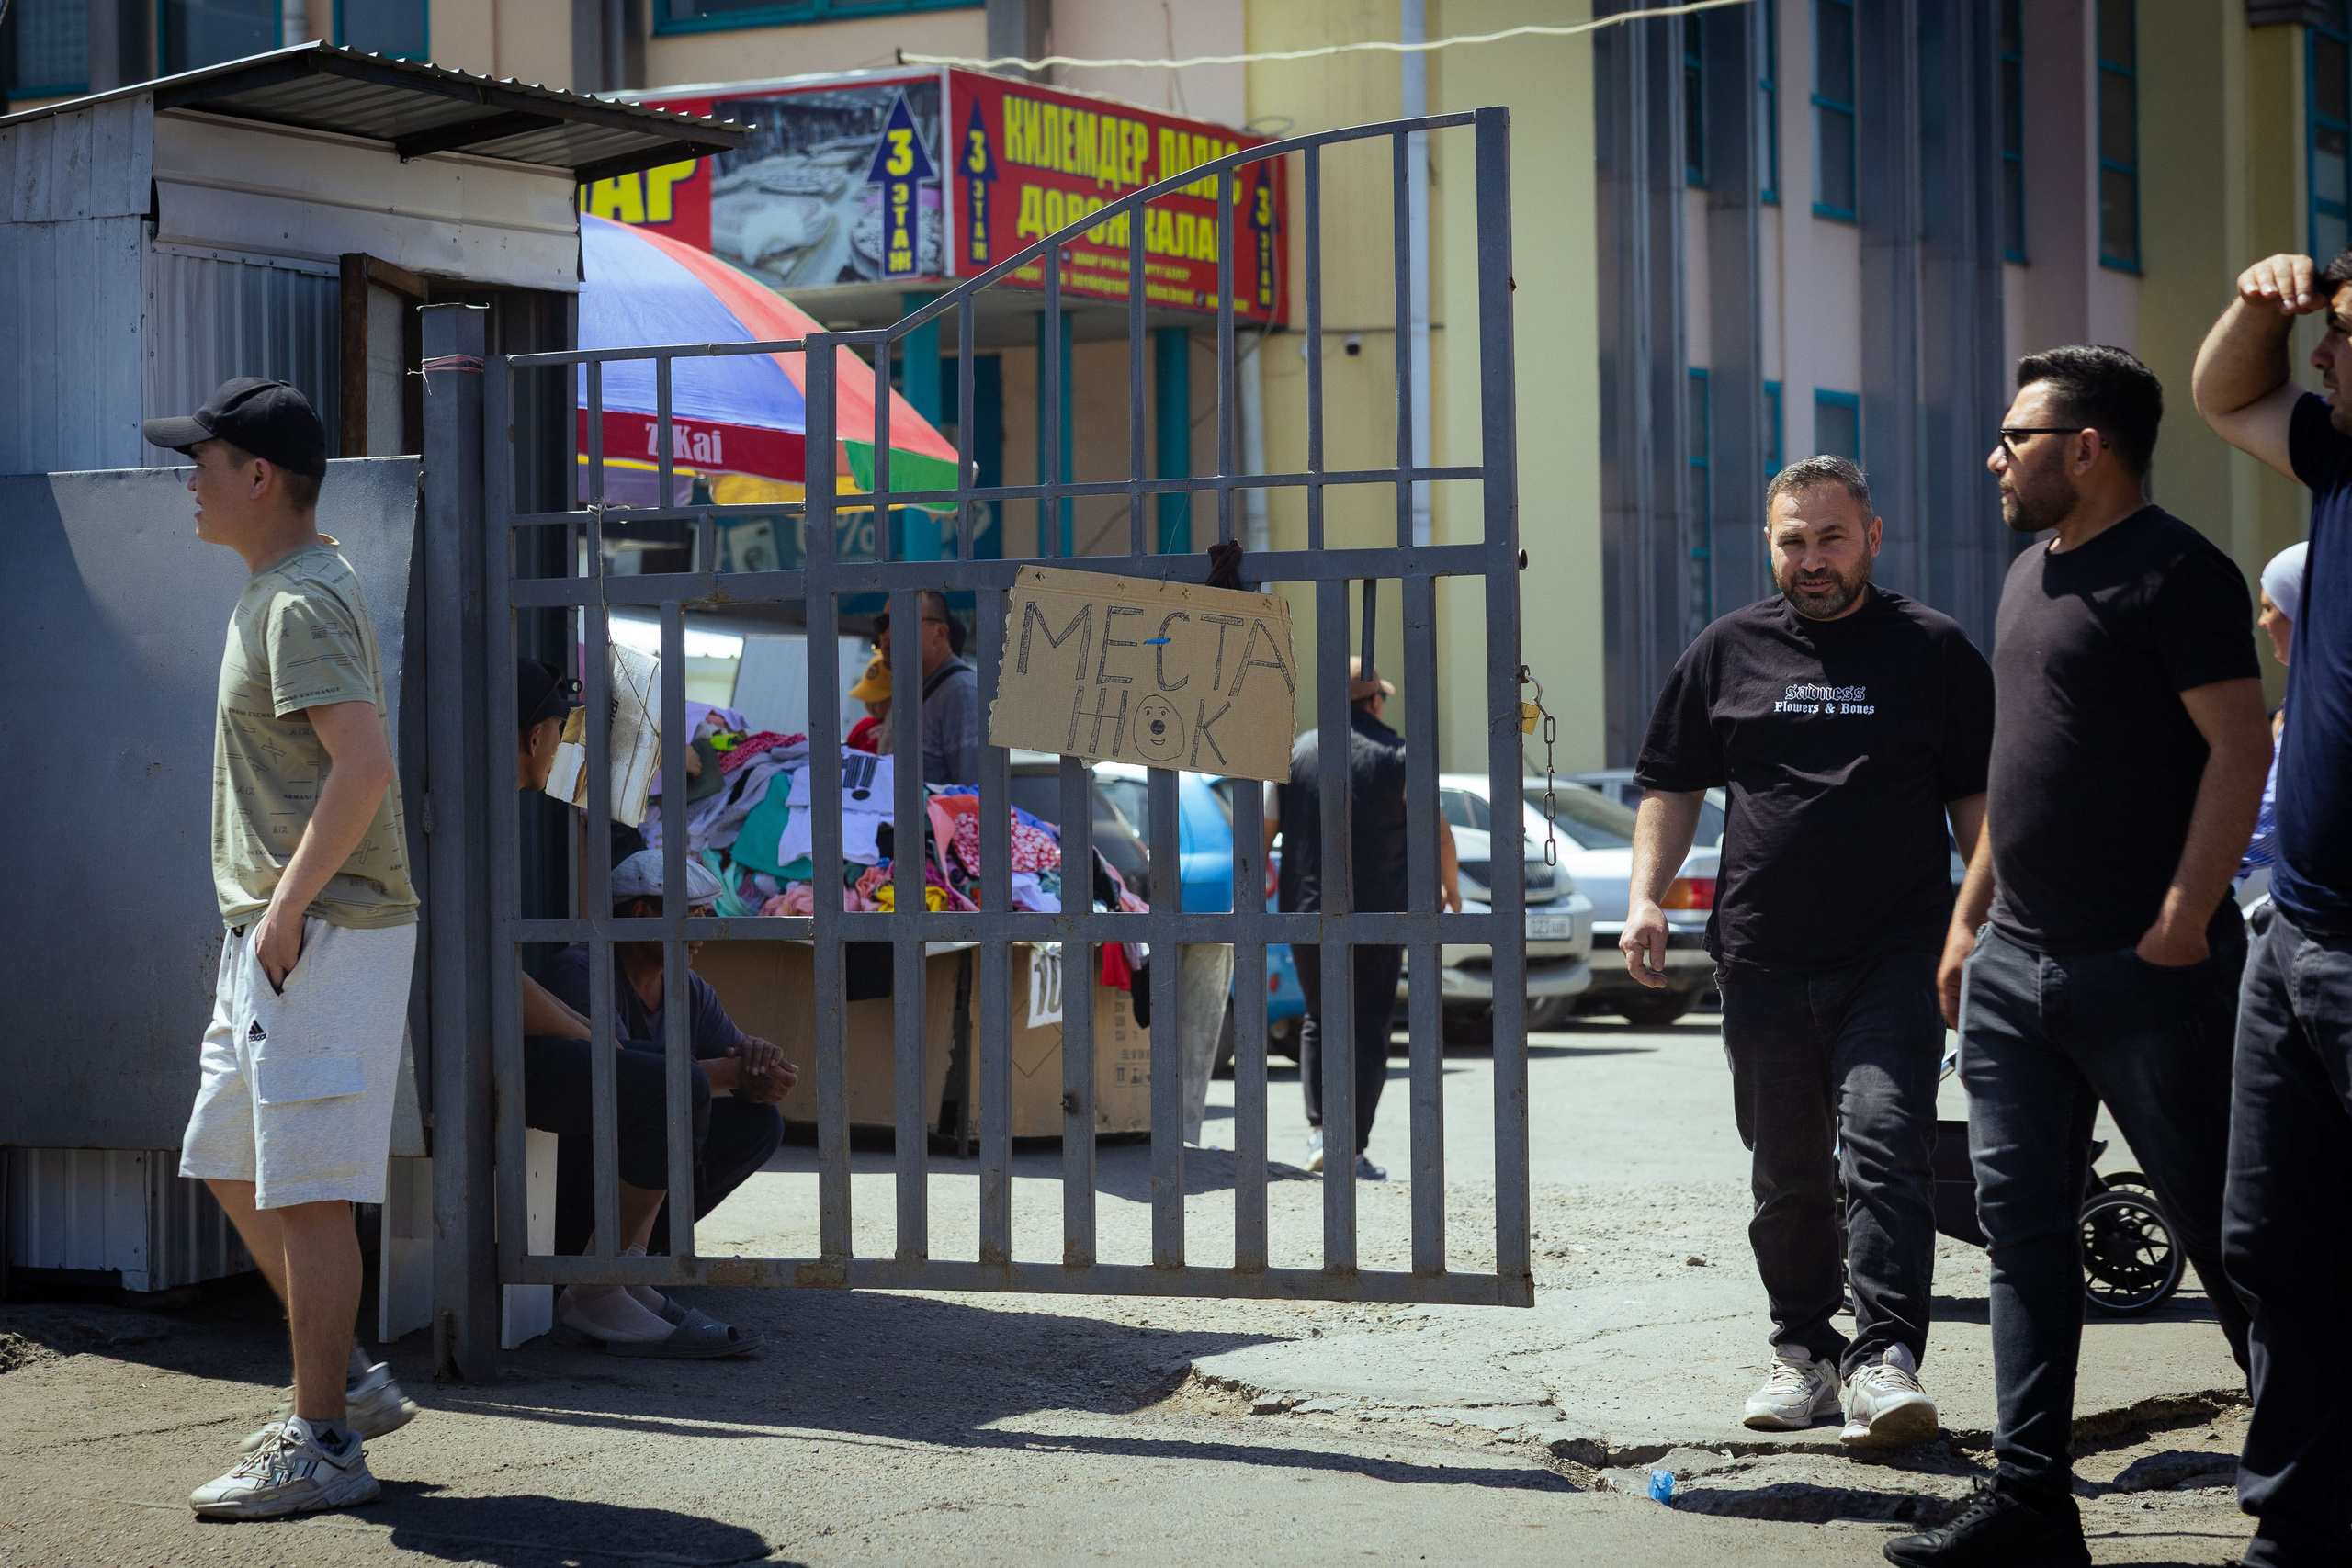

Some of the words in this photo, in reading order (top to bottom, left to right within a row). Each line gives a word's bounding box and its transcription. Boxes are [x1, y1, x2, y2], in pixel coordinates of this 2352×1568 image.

[886, 128, 914, 176] 3
[968, 129, 987, 174] 3
[580, 157, 697, 223] АР
[1256, 186, 1271, 226] 3
[888, 183, 912, 273] ЭТАЖ
[972, 179, 988, 261] ЭТАЖ
[1015, 184, 1219, 264] ДОРОЖКАЛА
[1016, 601, 1294, 696] МЕСТА
[1773, 701, 1819, 715] Flowers
[1825, 702, 1836, 715] &
[1840, 703, 1875, 716] Bones
[1785, 682, 1866, 702] sadness
